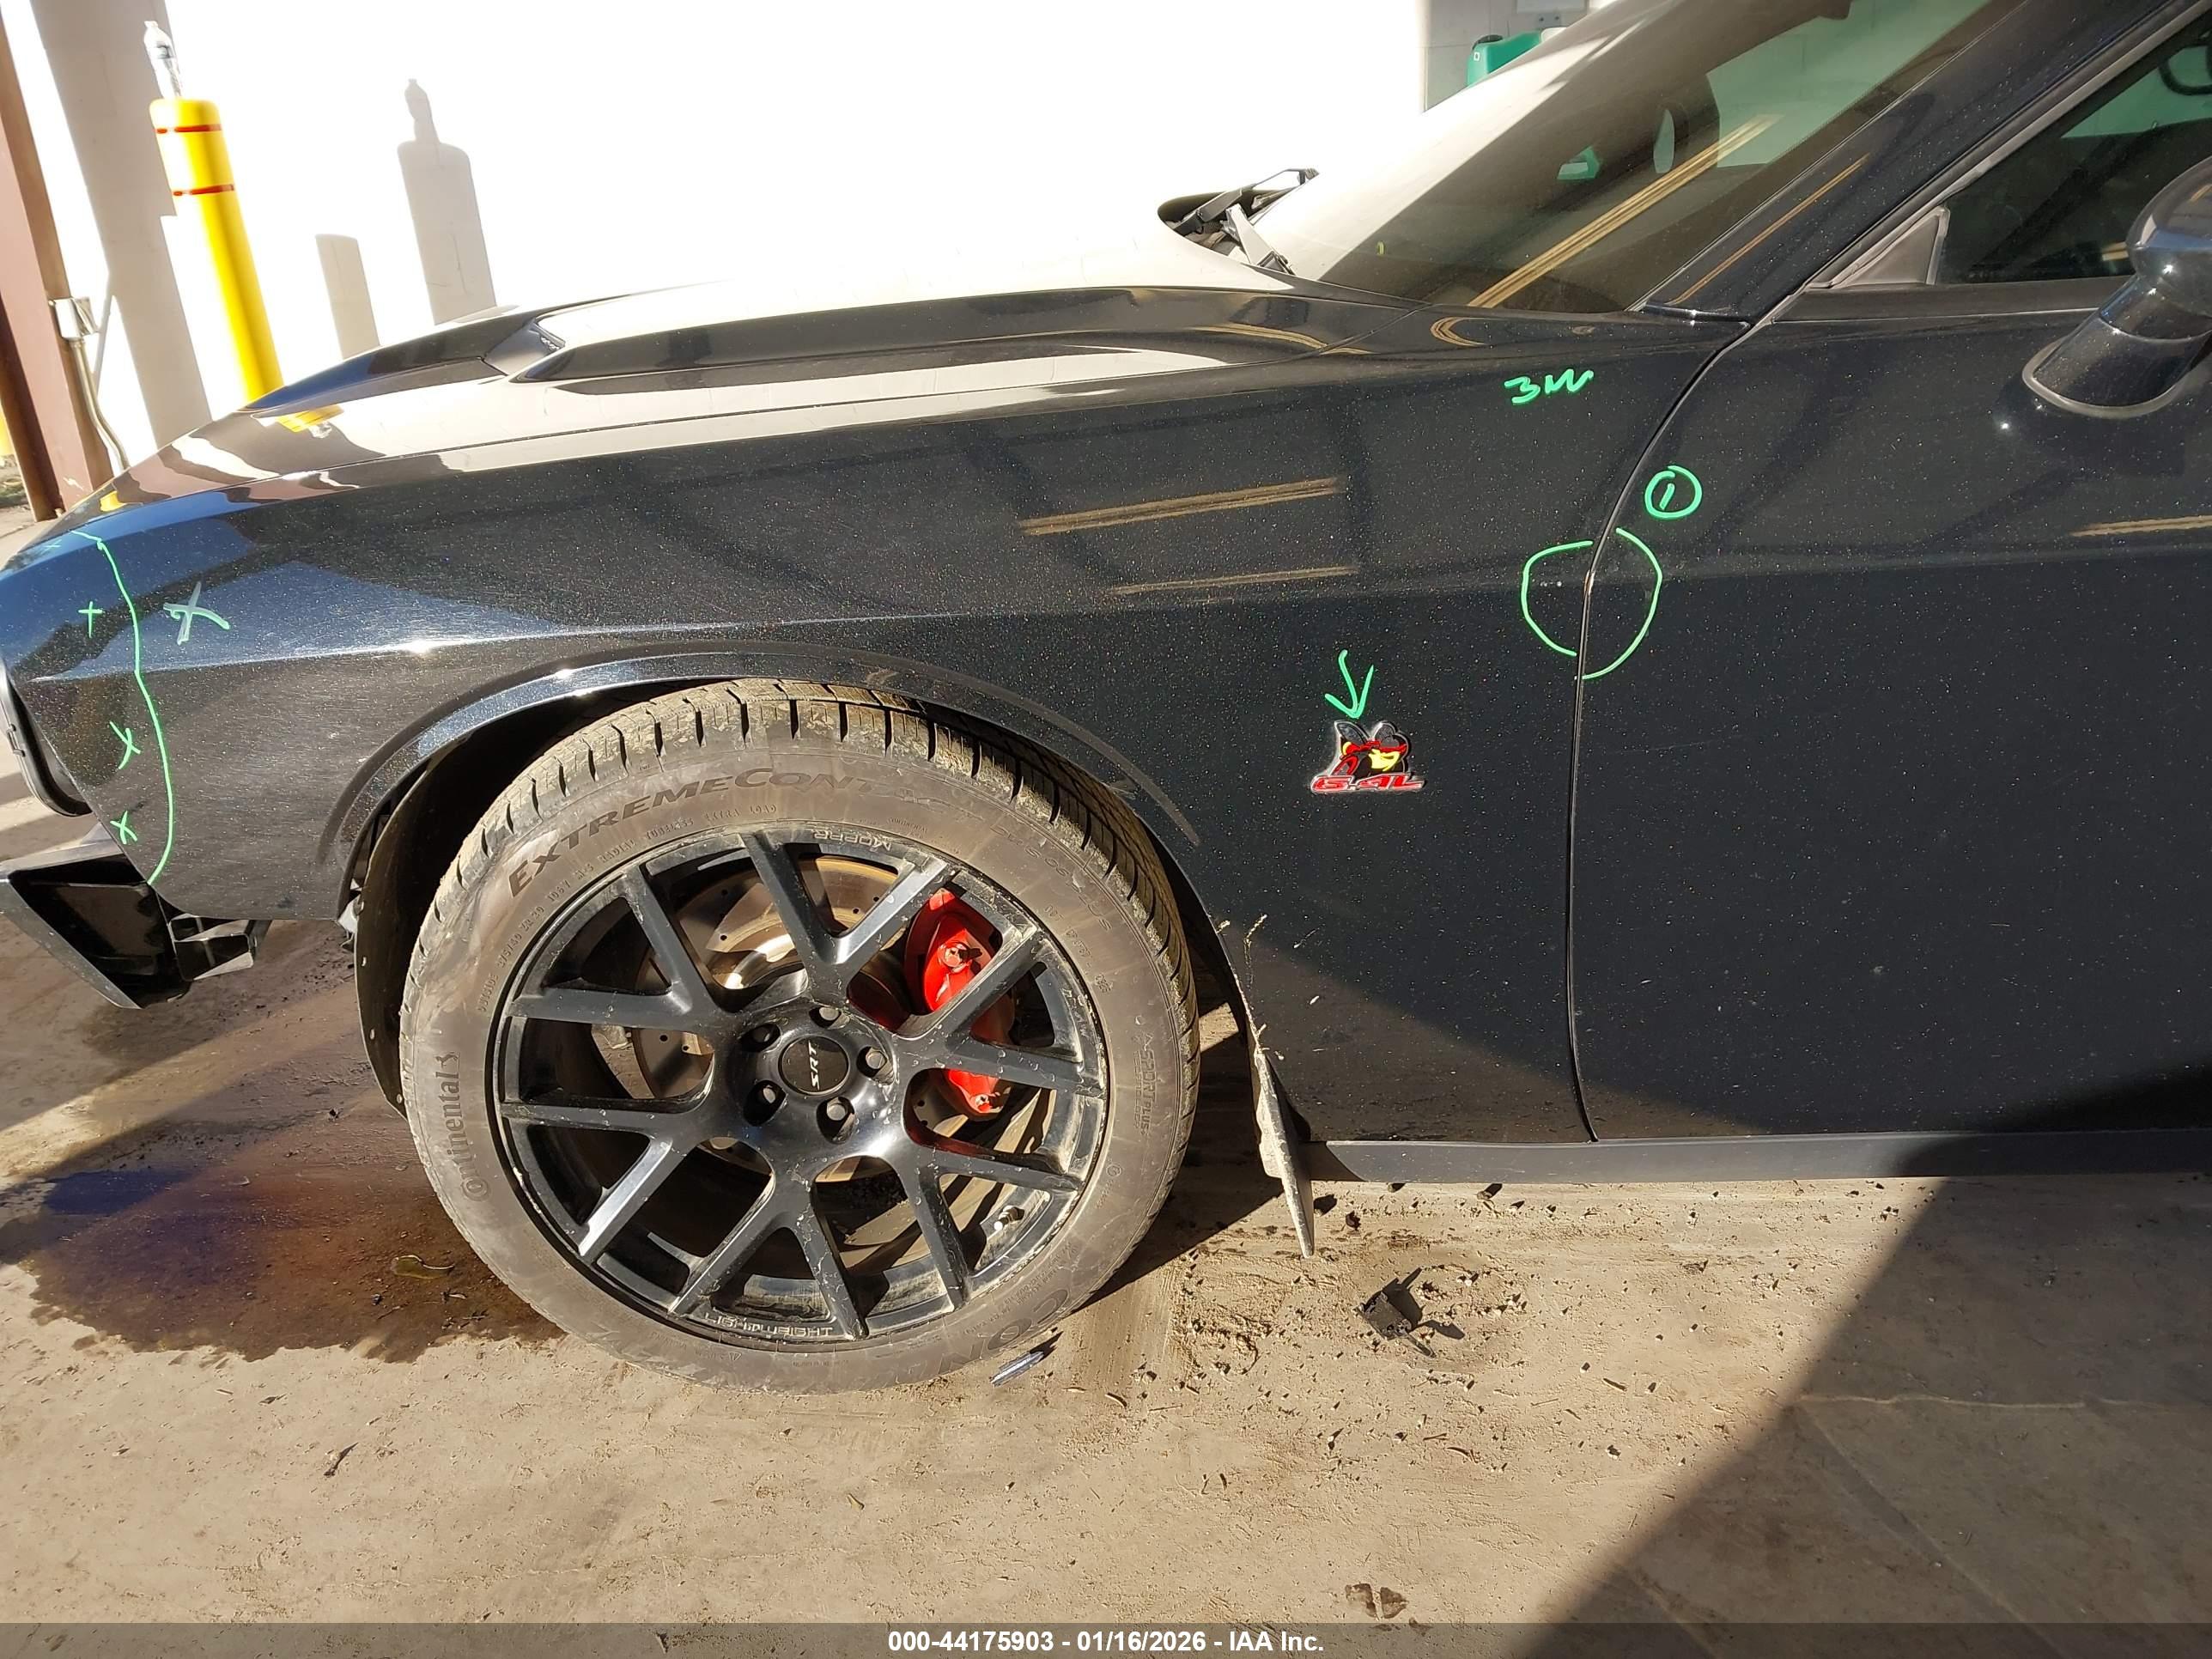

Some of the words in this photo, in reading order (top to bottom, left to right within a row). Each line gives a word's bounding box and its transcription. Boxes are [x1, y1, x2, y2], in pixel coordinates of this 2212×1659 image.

[1310, 772, 1425, 793] 6.4L
[814, 828, 893, 852] MOPAR
[808, 1039, 820, 1091] SRT
[434, 1071, 490, 1202] Continental
